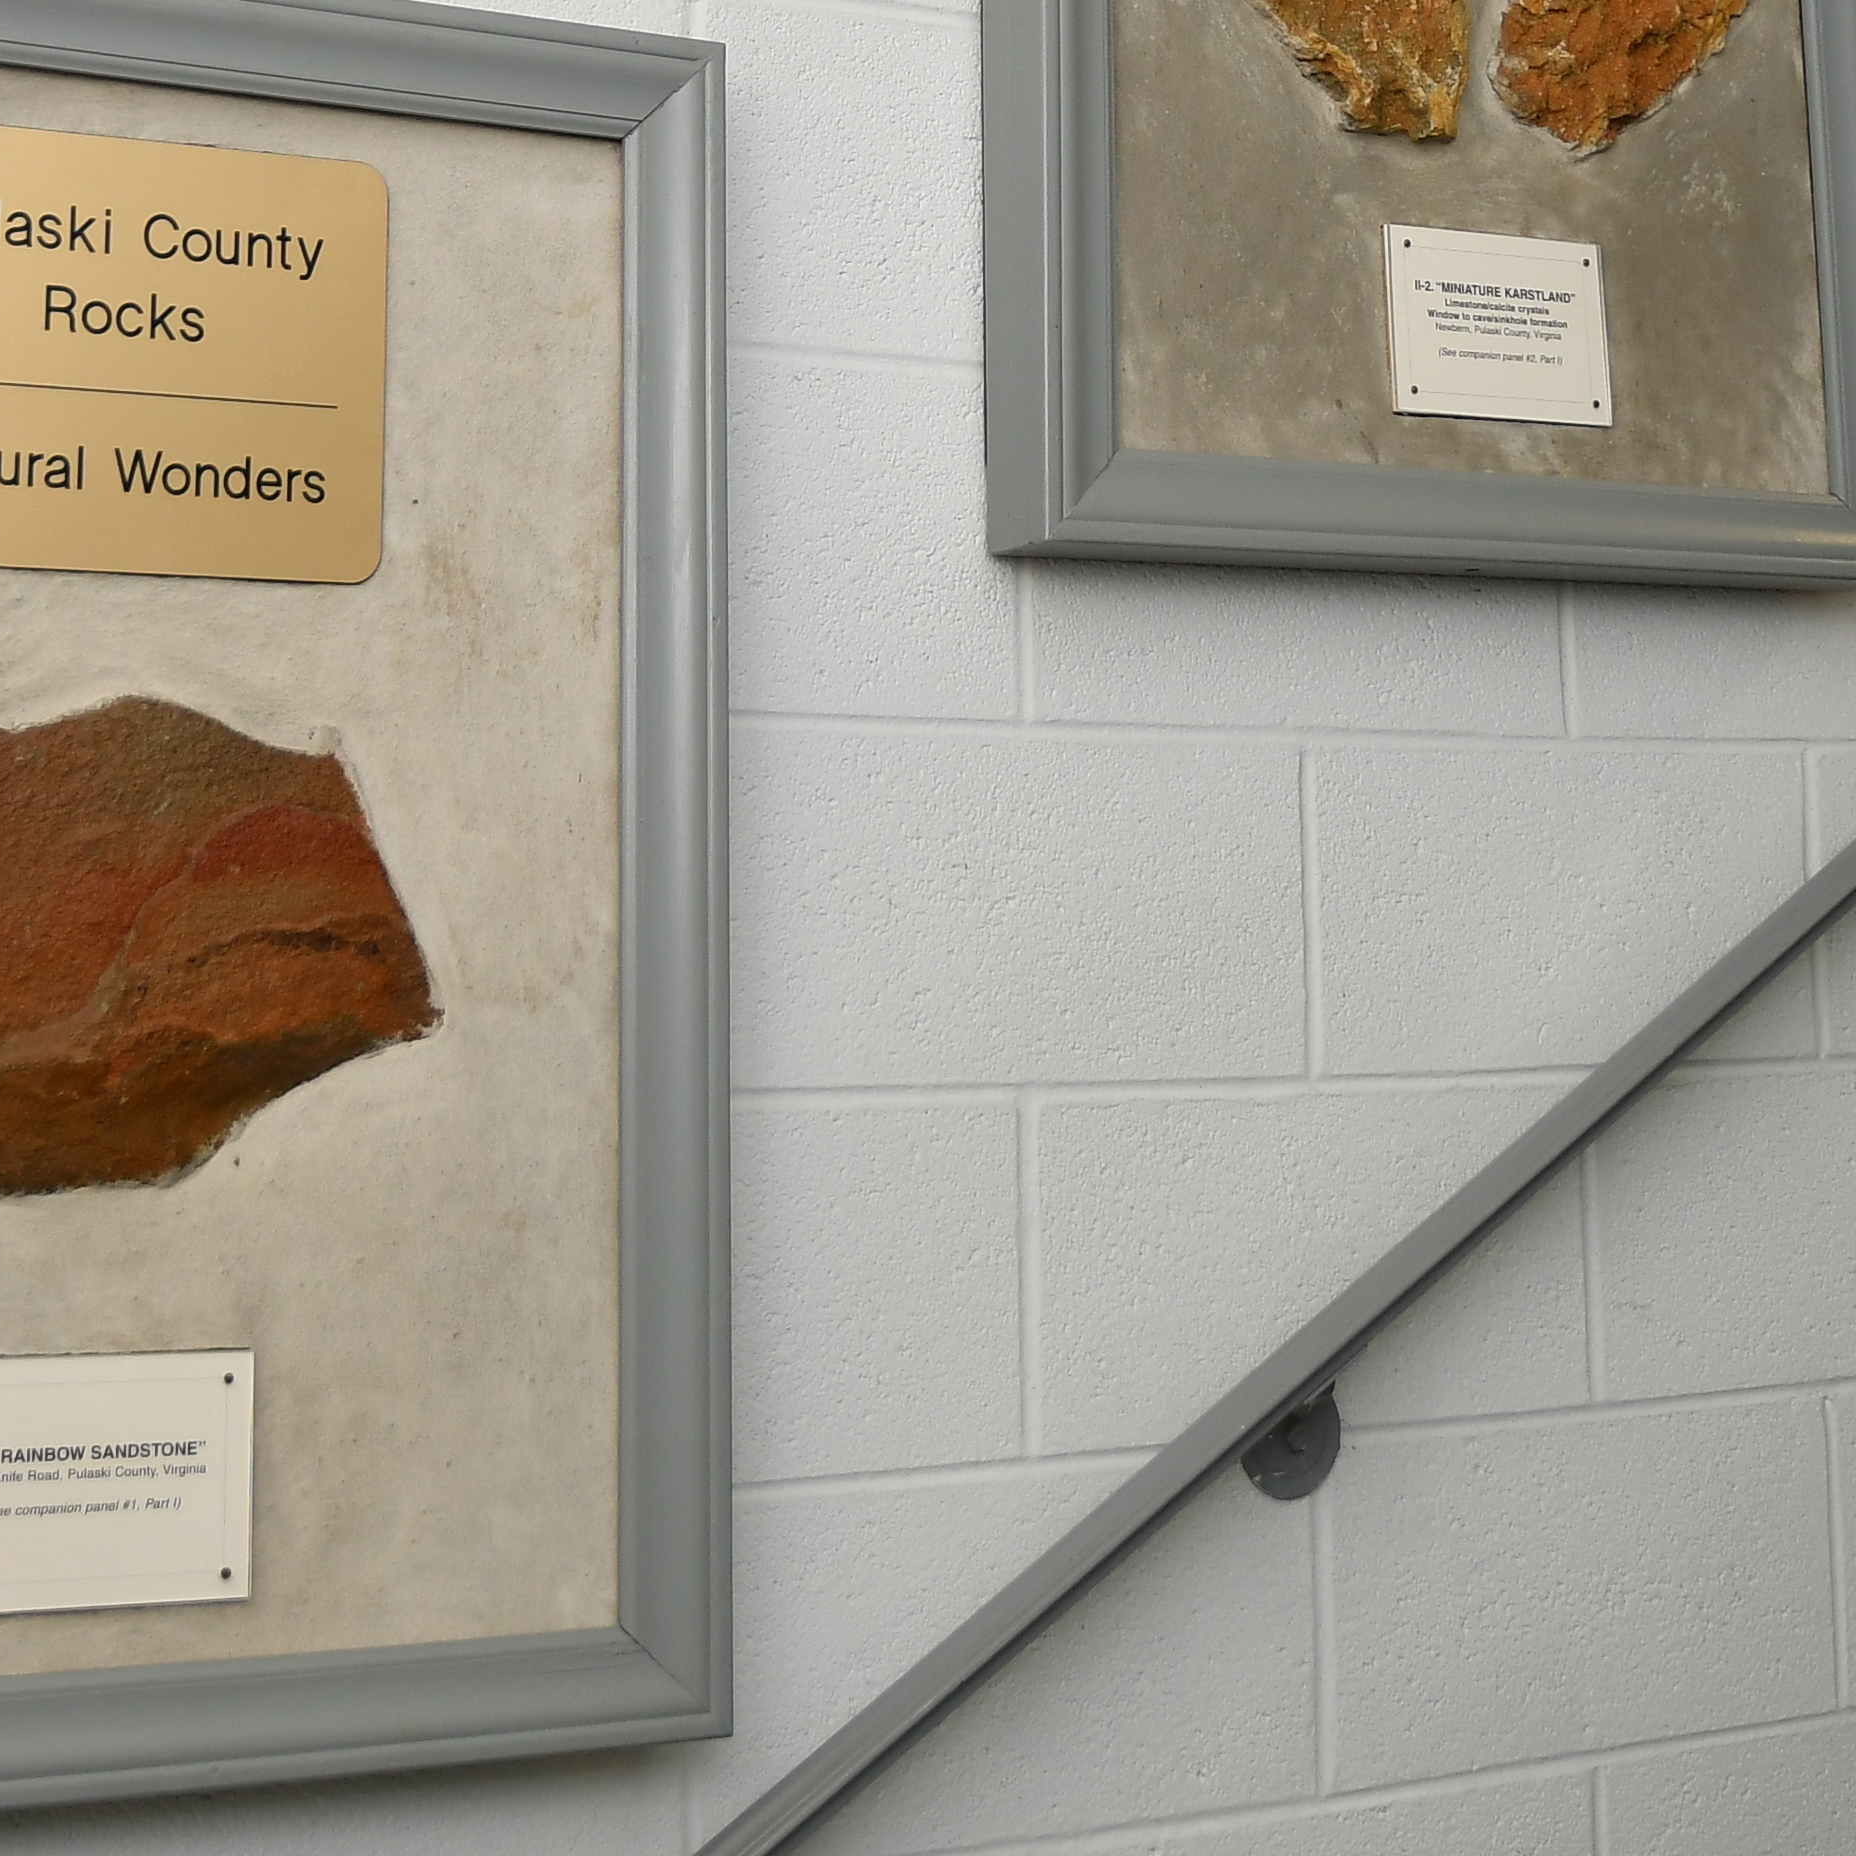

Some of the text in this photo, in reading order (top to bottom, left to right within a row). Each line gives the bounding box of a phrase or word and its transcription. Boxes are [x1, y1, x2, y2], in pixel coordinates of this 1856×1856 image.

[143, 213, 325, 281] County
[1414, 279, 1434, 292] II-2.
[44, 284, 206, 343] Rocks
[1426, 308, 1461, 320] Window
[1461, 311, 1471, 321] to
[1529, 316, 1569, 329] formation
[1473, 324, 1502, 336] Pulaski
[1532, 329, 1562, 342] Virginia
[1458, 349, 1501, 361] companion
[1502, 353, 1524, 363] panel
[1539, 354, 1556, 365] Part
[114, 447, 326, 504] Wonders
[27, 1467, 63, 1483] Road,
[67, 1465, 111, 1480] Pulaski
[114, 1465, 159, 1480] County,
[162, 1462, 207, 1478] Virginia
[14, 1502, 82, 1518] companion
[84, 1499, 120, 1516] panel
[144, 1497, 171, 1510] Part
[172, 1496, 182, 1511] I)
